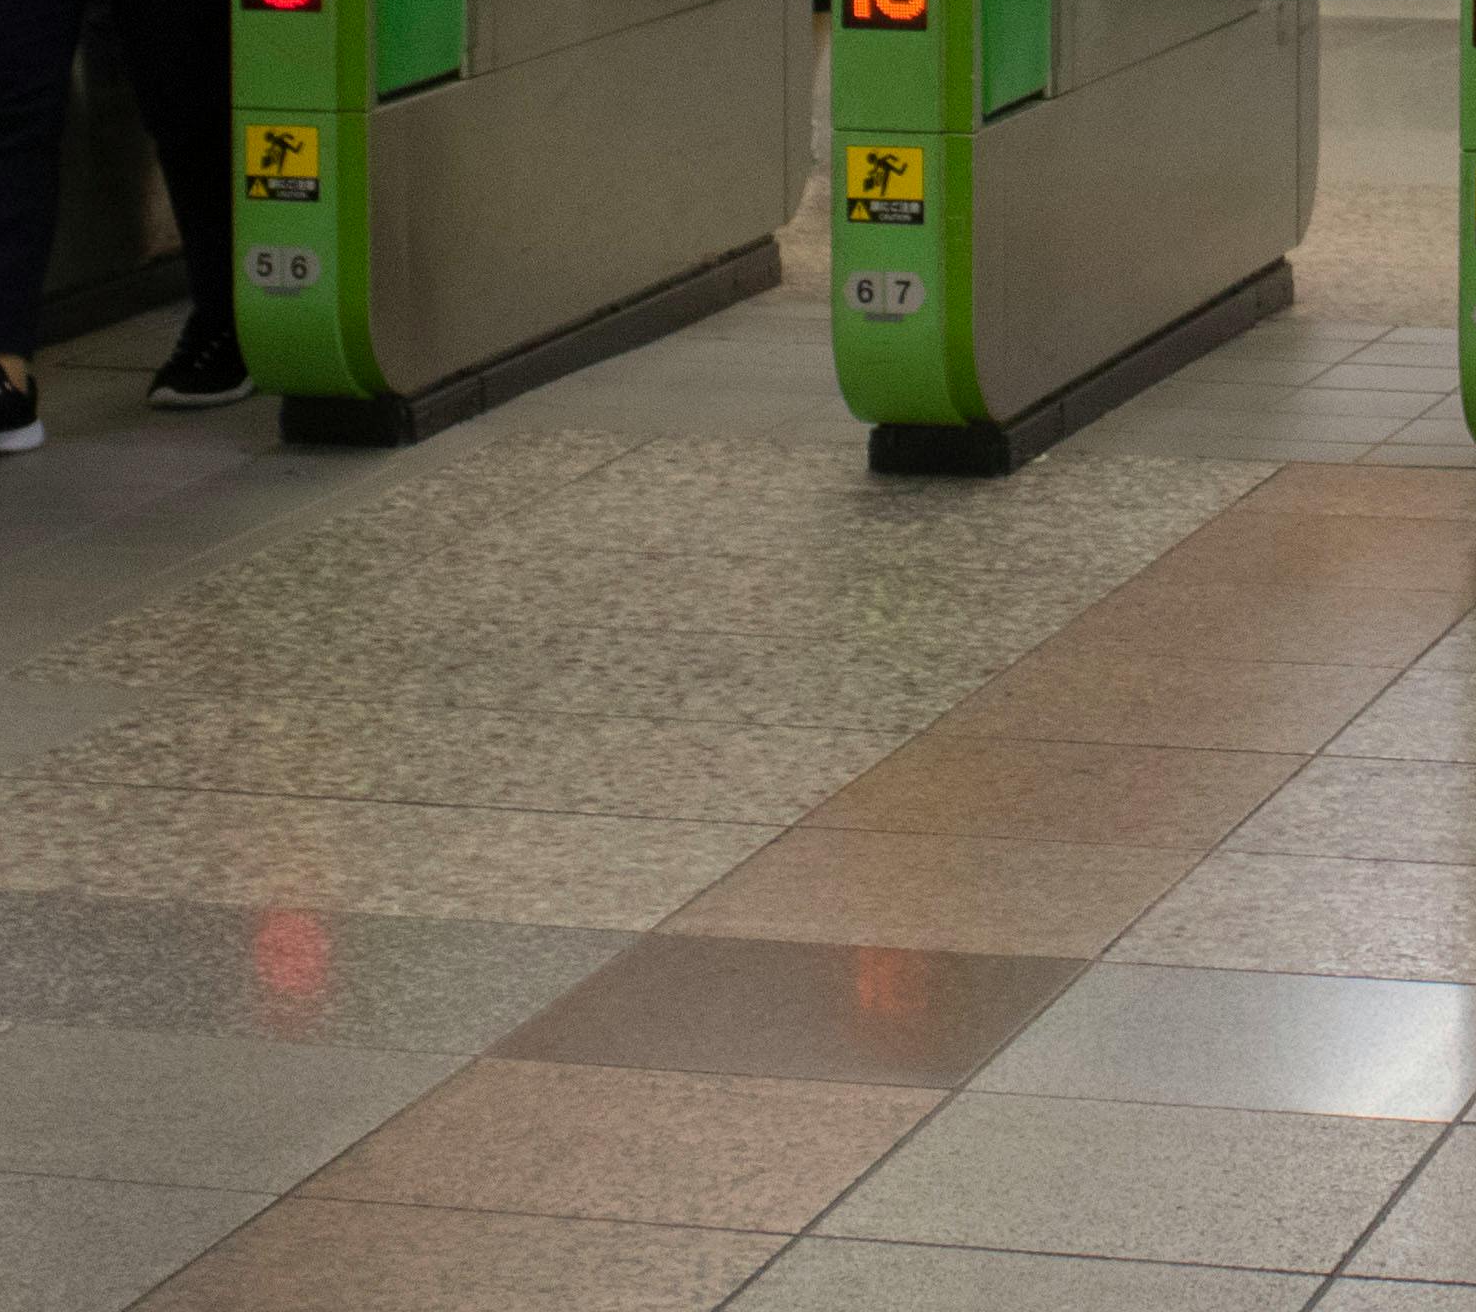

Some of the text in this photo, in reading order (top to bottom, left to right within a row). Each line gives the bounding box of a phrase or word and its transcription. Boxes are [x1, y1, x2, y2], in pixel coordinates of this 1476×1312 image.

[256, 252, 308, 281] 5 6
[856, 279, 911, 305] 6 7
